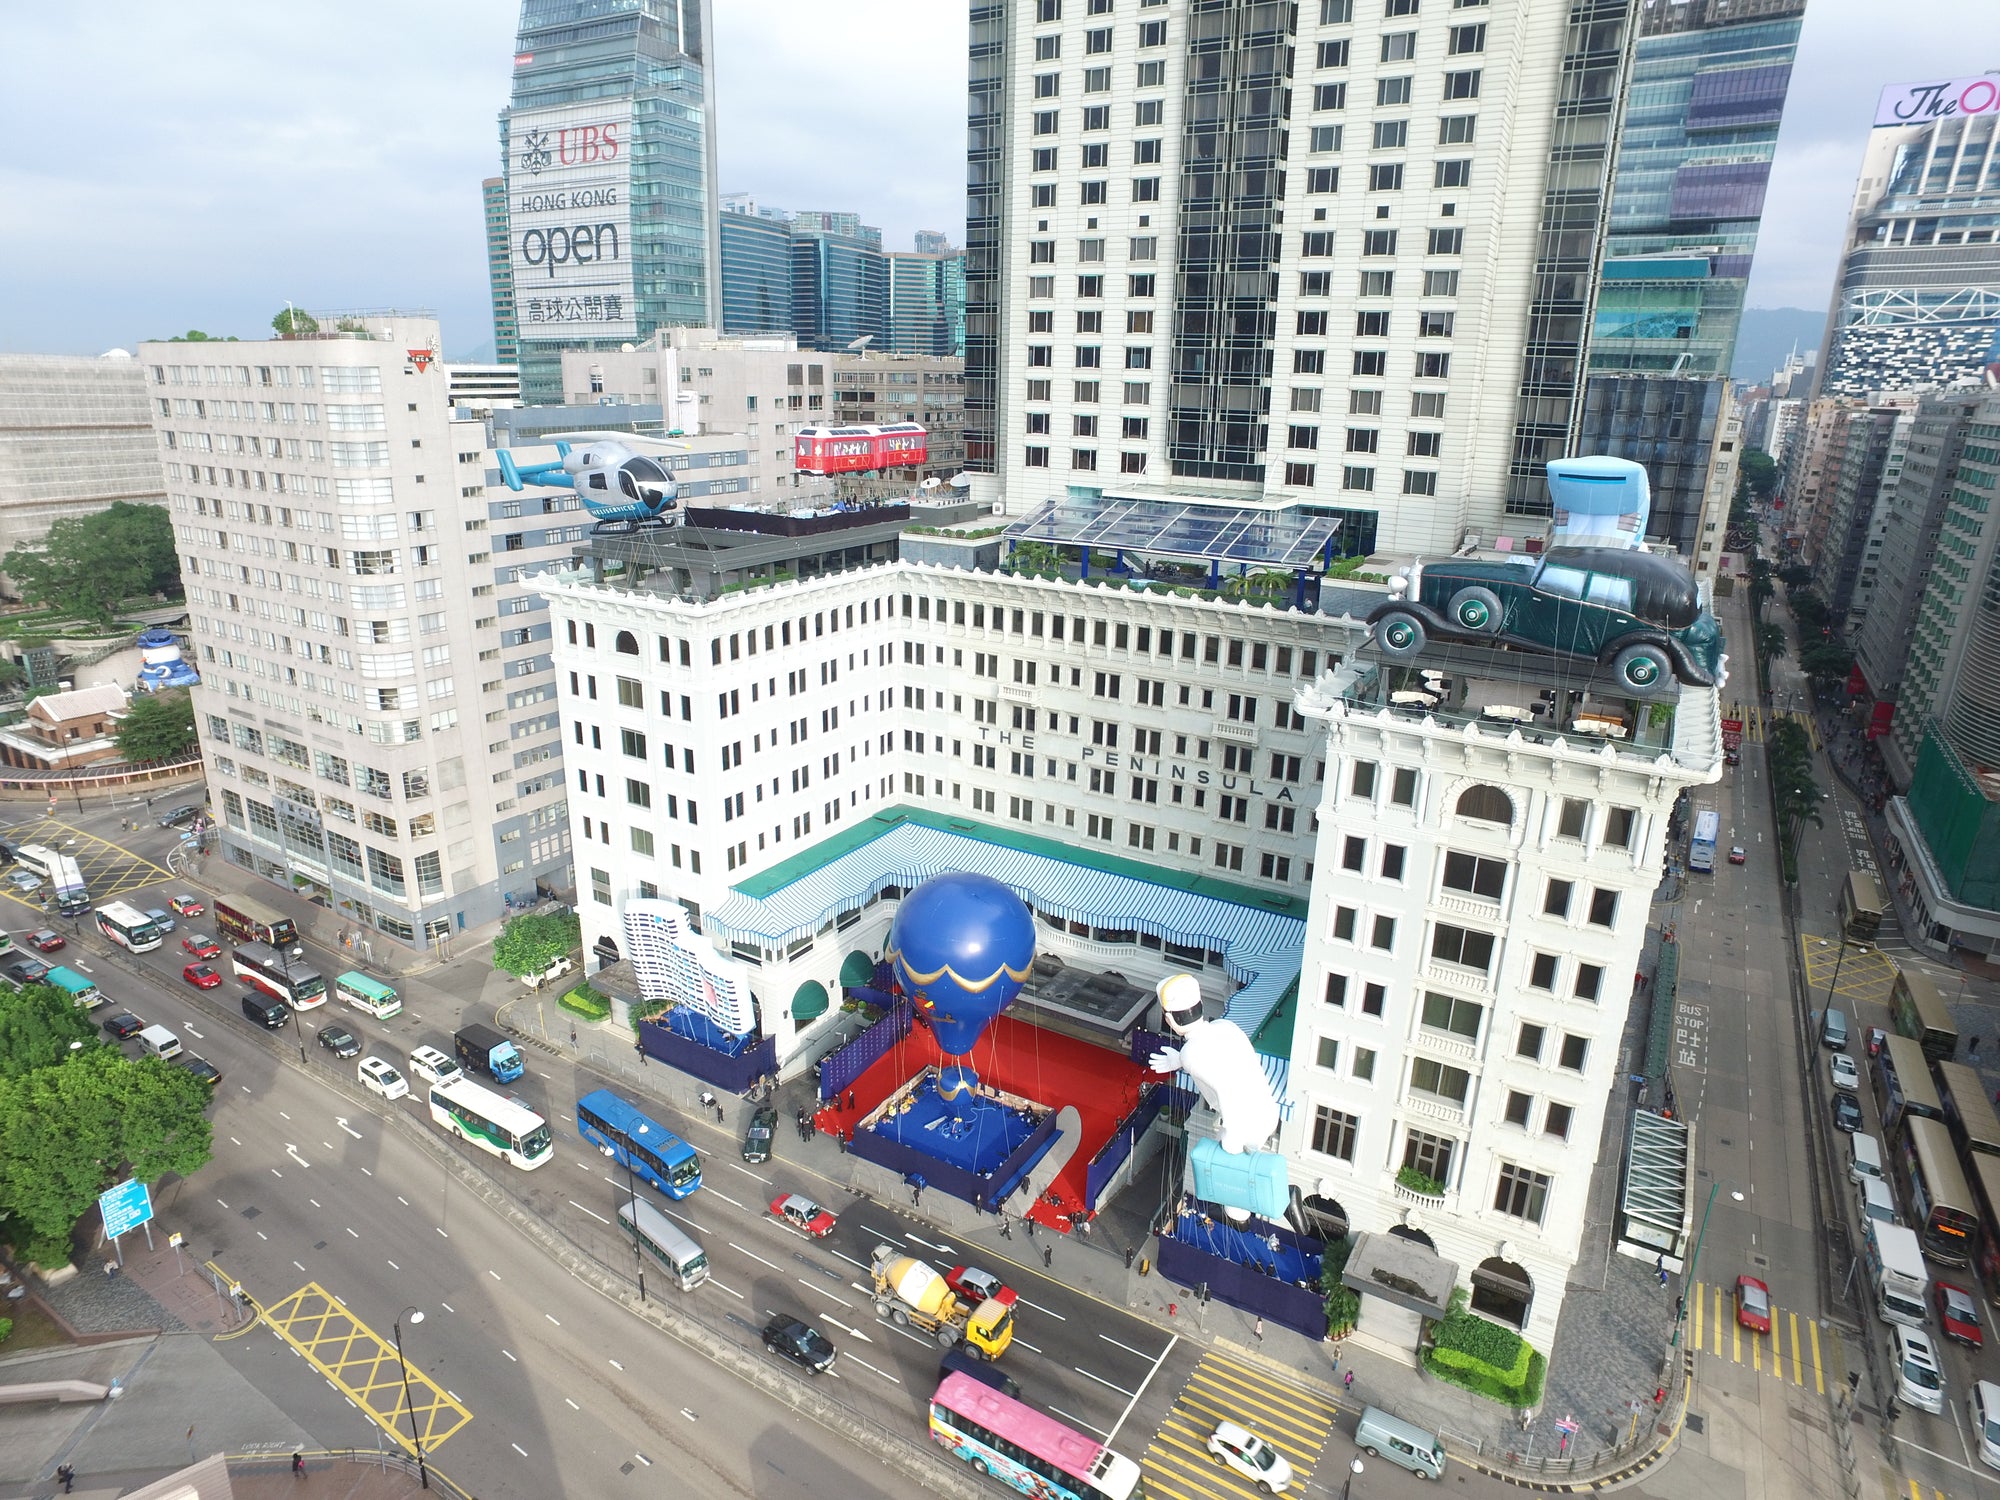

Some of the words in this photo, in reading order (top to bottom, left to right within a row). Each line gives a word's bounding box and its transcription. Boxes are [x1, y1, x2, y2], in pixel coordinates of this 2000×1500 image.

[1894, 82, 1957, 119] The
[558, 123, 618, 165] UBS
[521, 193, 566, 213] HONG
[571, 188, 617, 209] KONG
[522, 223, 619, 278] open
[527, 294, 624, 323] 高球公開賽
[591, 504, 636, 516] HELISERVICES
[978, 726, 1035, 749] THE
[1082, 746, 1294, 802] PENINSULA
[1675, 1015, 1704, 1029] STOP
[1679, 1003, 1702, 1016] BUS
[1676, 1028, 1701, 1048] 巴士
